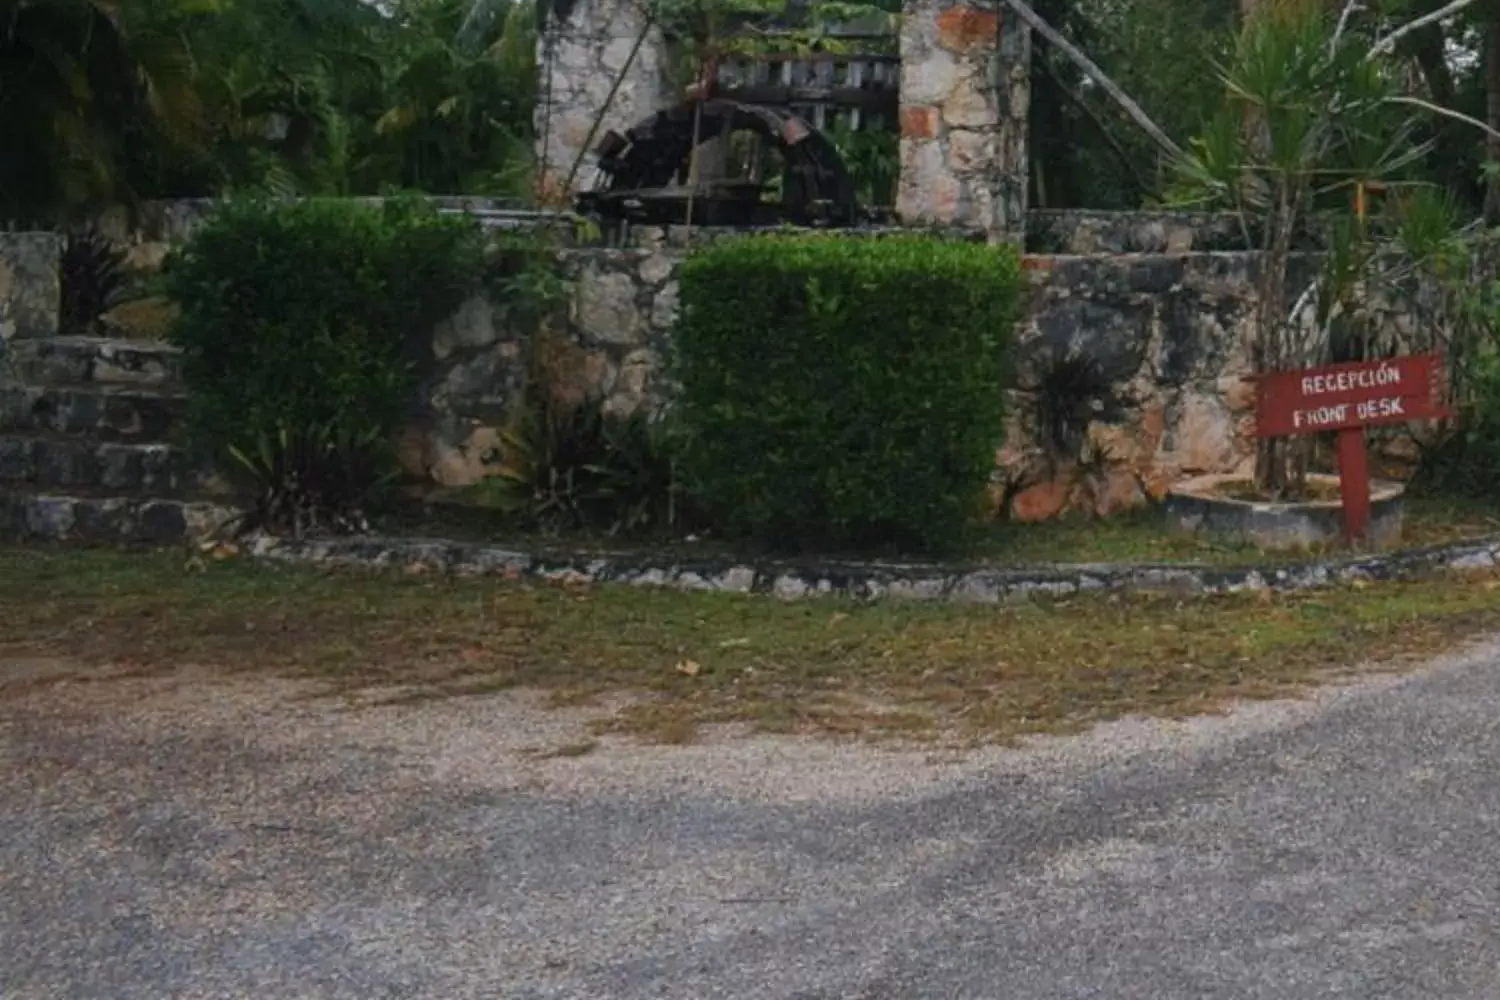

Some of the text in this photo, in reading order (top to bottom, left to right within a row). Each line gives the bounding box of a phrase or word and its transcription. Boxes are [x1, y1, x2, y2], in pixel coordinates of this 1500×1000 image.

[1302, 362, 1400, 395] RECEPCIÓN
[1293, 396, 1405, 428] FRONT DESK
